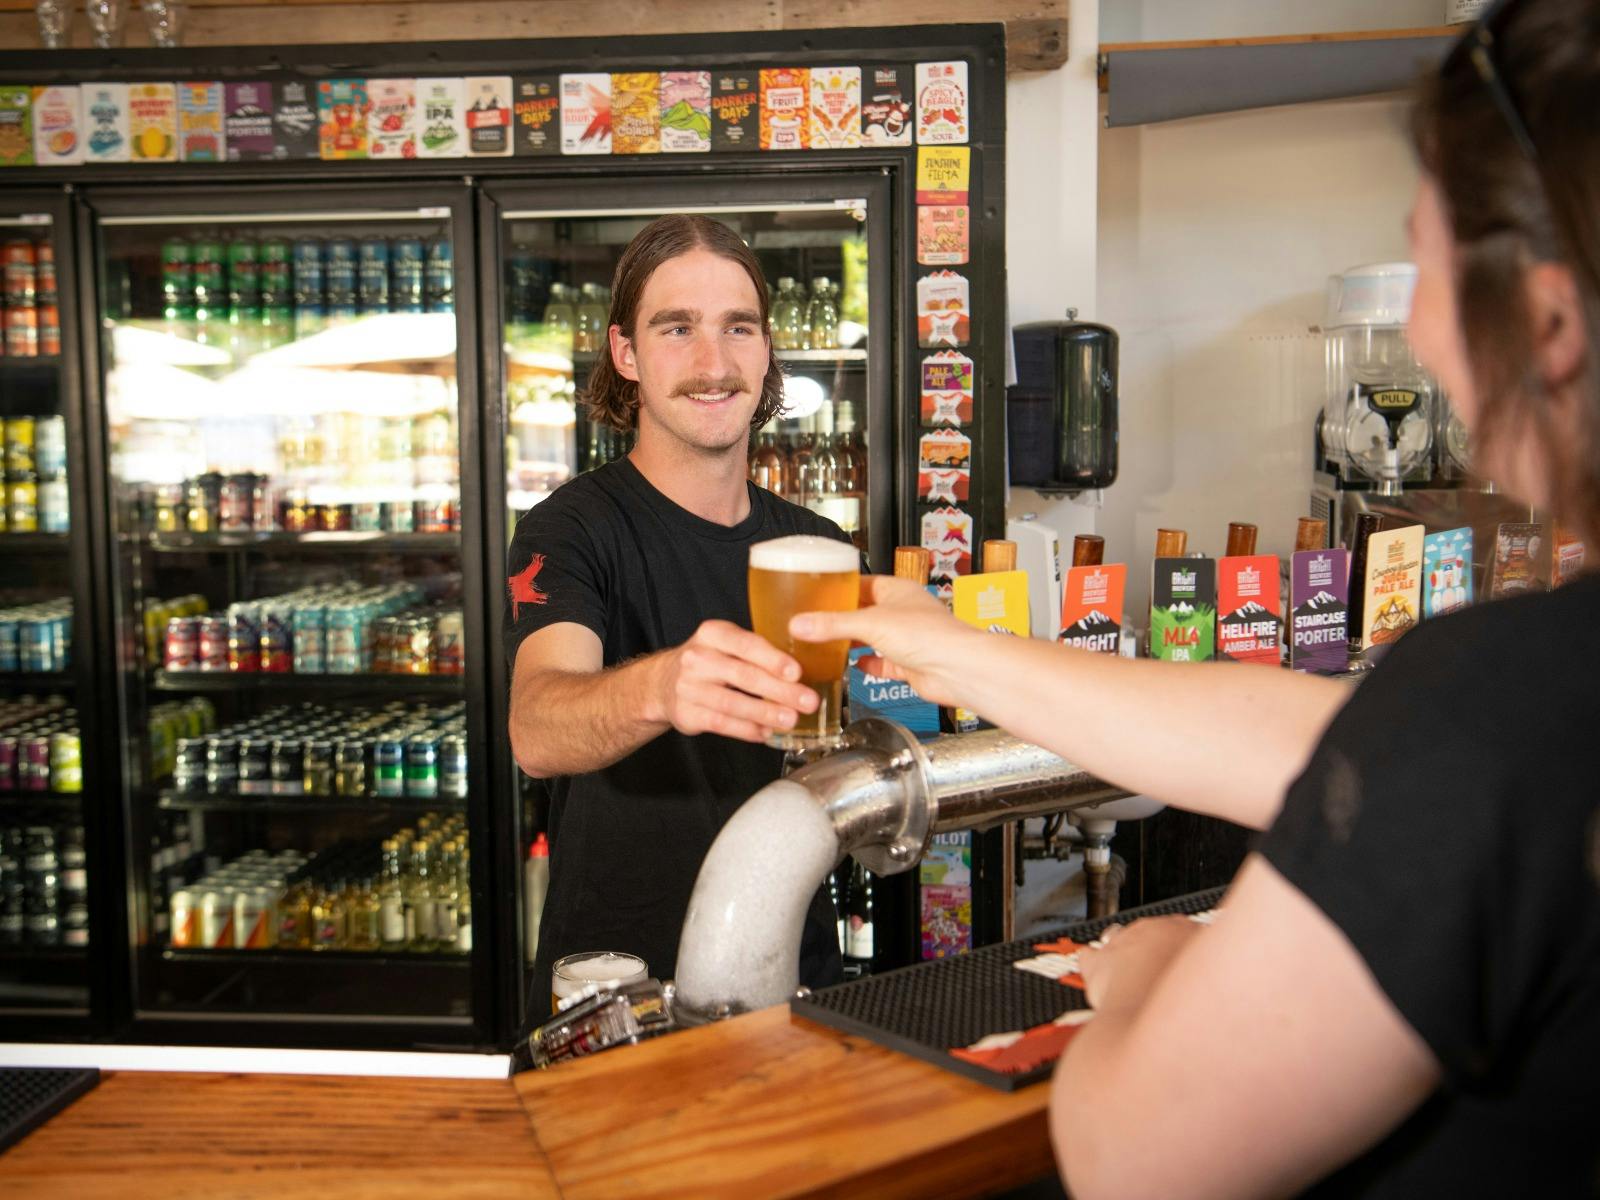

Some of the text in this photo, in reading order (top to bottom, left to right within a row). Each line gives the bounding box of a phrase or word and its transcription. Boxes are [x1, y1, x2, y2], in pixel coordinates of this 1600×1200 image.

[713, 93, 757, 109] DARKER
[427, 109, 454, 120] IPA
[521, 110, 552, 125] DAYS
[719, 105, 750, 120] DAYS
[929, 367, 948, 376] PALE
[1381, 394, 1408, 403] PULL
[1171, 571, 1197, 586] BRIGHT
[1295, 611, 1347, 628] STAIRCASE
[1221, 621, 1277, 639] HELLFIRE
[1295, 627, 1346, 646] PORTER
[1224, 638, 1275, 653] AMBER ALE
[1171, 648, 1190, 661] IPA
